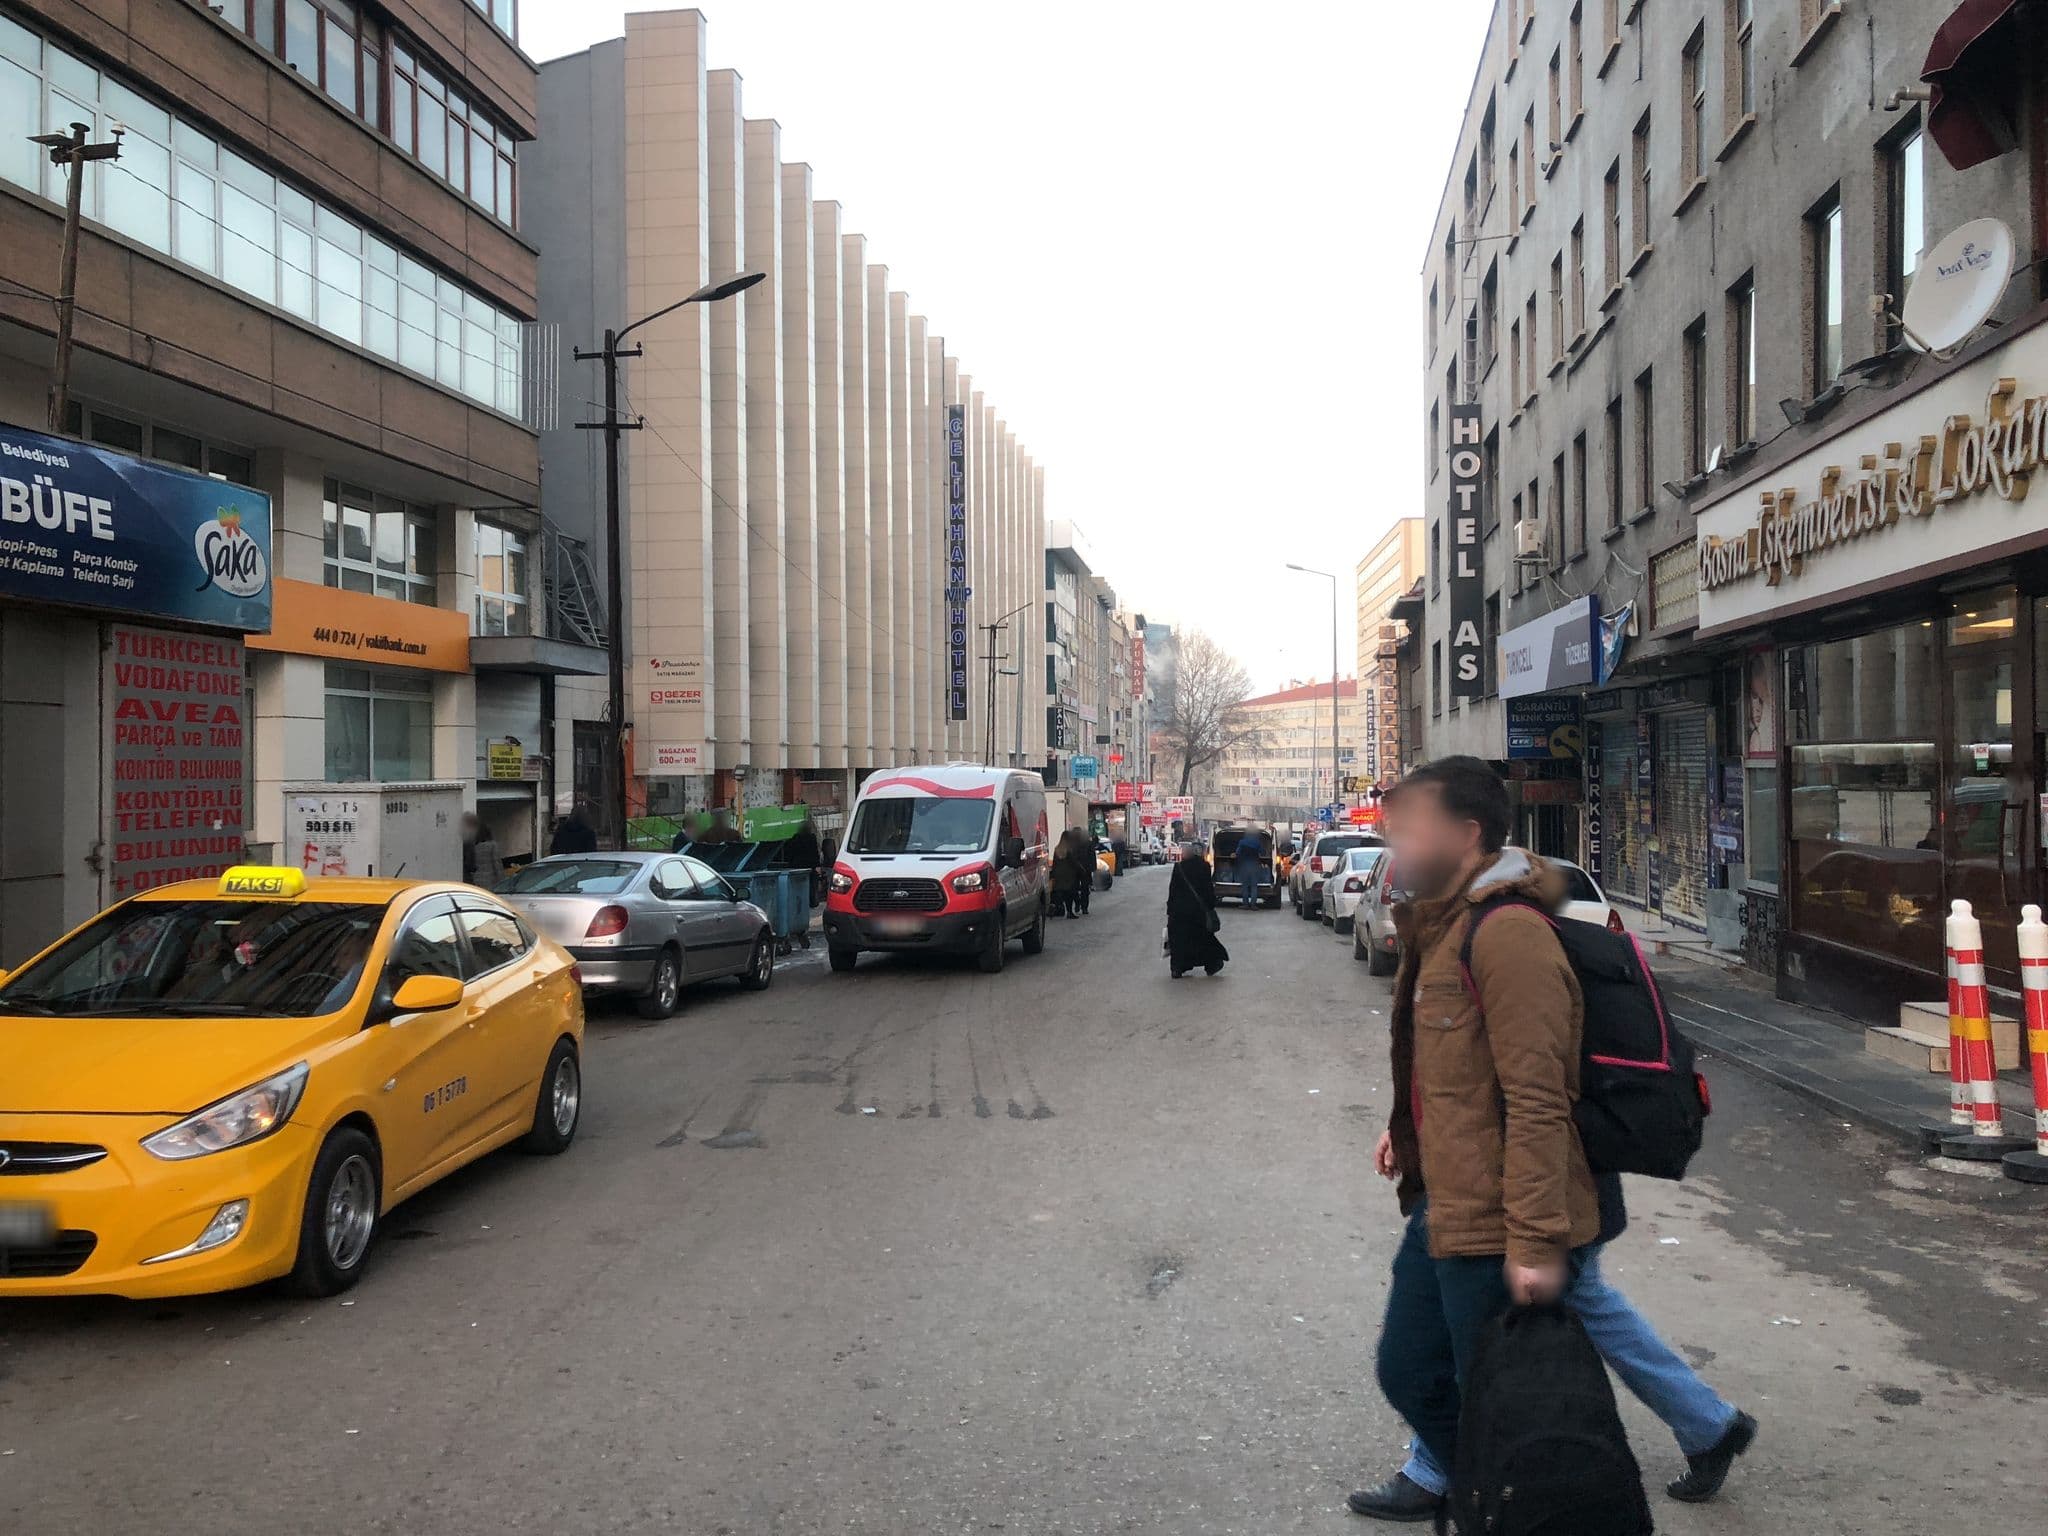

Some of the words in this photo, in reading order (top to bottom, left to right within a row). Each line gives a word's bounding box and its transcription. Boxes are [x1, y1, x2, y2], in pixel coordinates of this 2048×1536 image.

[1, 442, 70, 469] Belediyesi
[0, 474, 115, 541] BÜFE
[1452, 417, 1481, 578] HOTEL
[12, 557, 65, 578] Kaplama
[73, 568, 110, 585] Telefon
[73, 550, 102, 567] Parça
[104, 556, 138, 573] Kontör
[1701, 534, 1760, 591] Bosna
[115, 631, 241, 669] TURKCELL
[313, 627, 331, 643] 444
[332, 630, 339, 643] 0
[340, 631, 357, 646] 724
[952, 607, 965, 709] HOTEL
[1453, 620, 1481, 682] AS
[114, 662, 241, 697] VODAFONE
[664, 690, 701, 698] GEZER
[114, 698, 241, 725] AVEA
[115, 724, 176, 752] PARÇA
[182, 731, 202, 747] ve
[208, 727, 242, 747] TAM
[179, 759, 242, 781] BULUNUR
[115, 785, 242, 810] KONTÖRLÜ
[115, 809, 242, 832] TELEFON
[114, 836, 241, 862] BULUNUR
